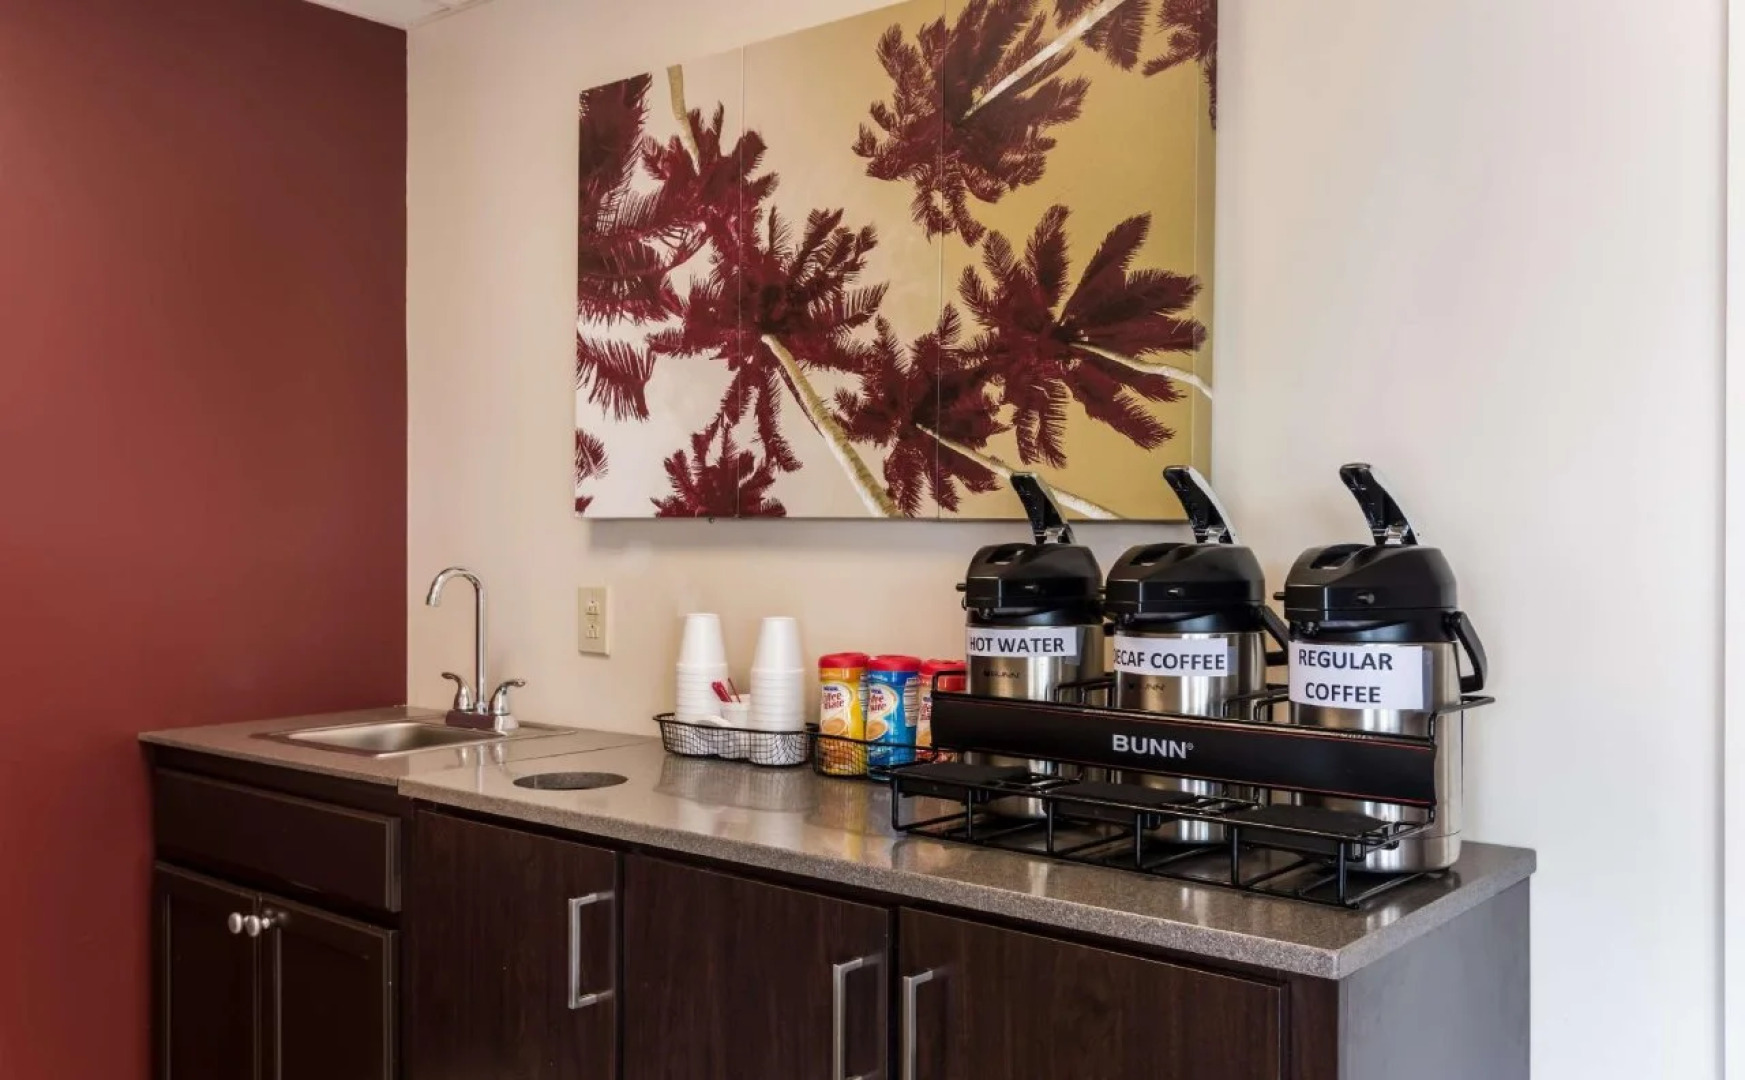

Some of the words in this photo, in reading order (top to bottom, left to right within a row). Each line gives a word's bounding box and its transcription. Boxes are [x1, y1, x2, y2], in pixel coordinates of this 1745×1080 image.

[970, 636, 993, 652] HOT
[998, 637, 1065, 653] WATER
[1113, 648, 1145, 668] ECAF
[1151, 653, 1225, 670] COFFEE
[1298, 648, 1393, 671] REGULAR
[1305, 682, 1382, 704] COFFEE
